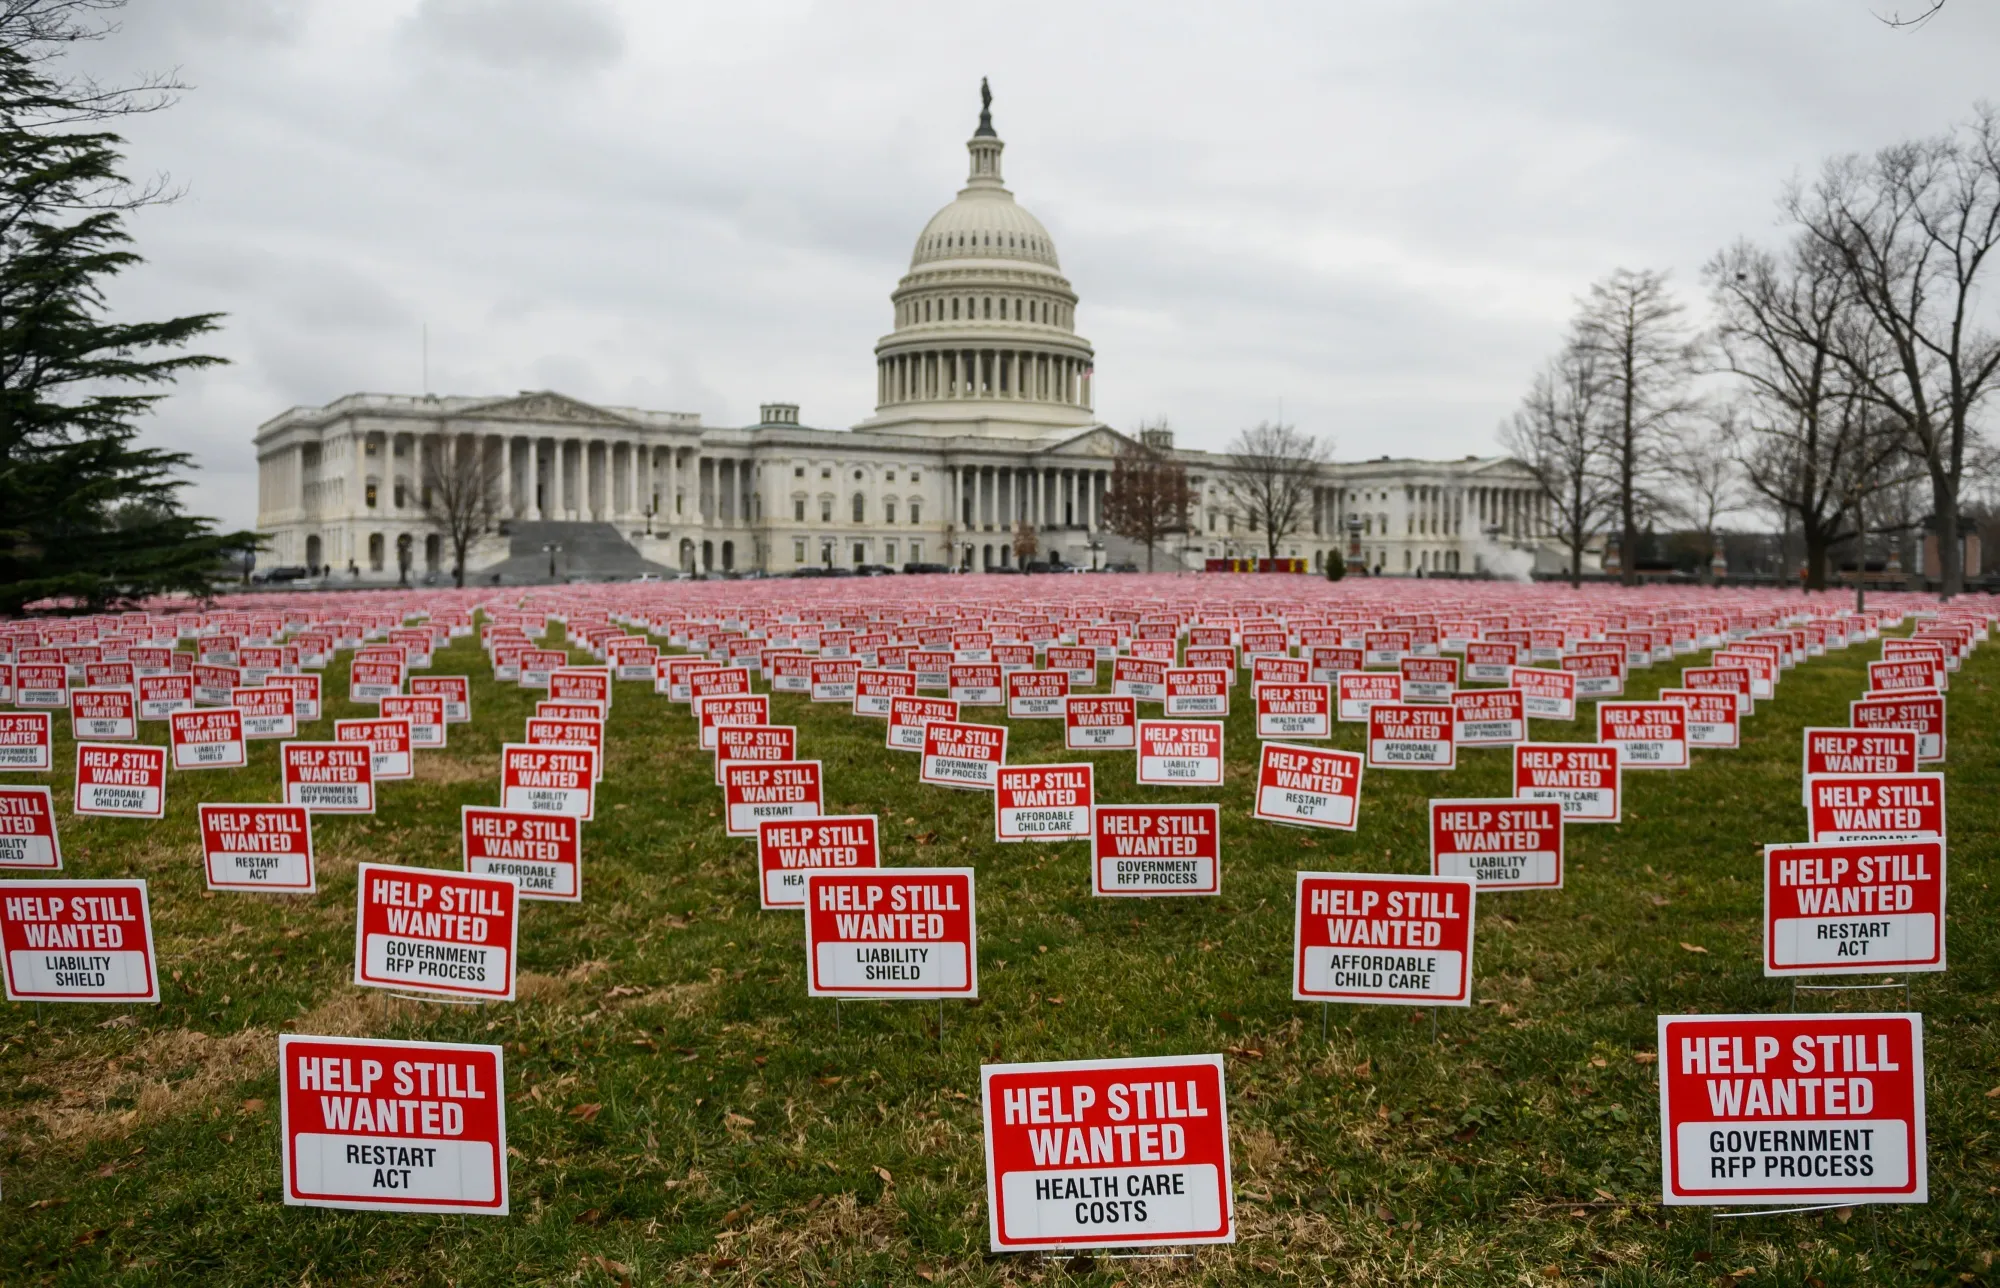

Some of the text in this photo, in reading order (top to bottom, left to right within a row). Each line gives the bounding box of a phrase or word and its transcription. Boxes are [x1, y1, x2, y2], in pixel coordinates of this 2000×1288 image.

[1263, 689, 1324, 701] HELP STILL
[1270, 702, 1317, 713] WANTED
[16, 718, 45, 731] STILL
[176, 715, 238, 730] HELP STILL
[1375, 713, 1449, 726] HELP STILL
[1605, 710, 1680, 724] HELP STILL
[184, 728, 232, 743] WANTED
[722, 734, 789, 746] HELP STILL
[929, 729, 1000, 748] HELP STILL
[1145, 727, 1216, 742] HELP STILL
[1382, 727, 1440, 740] WANTED
[1613, 725, 1671, 738] WANTED
[730, 747, 781, 759] WANTED
[935, 744, 990, 760] WANTED
[1152, 742, 1208, 756] WANTED
[1813, 737, 1857, 755] HELP
[1862, 738, 1909, 756] STILL
[84, 751, 159, 770] HELP STILL
[289, 751, 365, 766] HELP STILL
[510, 753, 589, 771] HELP STILL
[935, 760, 987, 772] GOVERNMENT
[1268, 752, 1355, 778] HELP STILL
[1522, 753, 1611, 770] HELP STILL
[1823, 756, 1897, 773] WANTED
[91, 768, 149, 785] WANTED
[297, 766, 356, 781] WANTED
[518, 770, 578, 787] WANTED
[732, 770, 814, 786] HELP STILL
[1003, 772, 1085, 790] HELP STILL
[1276, 770, 1342, 794] WANTED
[1533, 772, 1601, 787] WANTED
[93, 788, 146, 799] AFFORDABLE
[742, 787, 804, 802] WANTED
[1012, 790, 1075, 807] WANTED
[1285, 793, 1327, 807] RESTART
[1574, 791, 1599, 801] CARE
[1819, 785, 1933, 806] HELP STILL
[0, 797, 44, 815] STILL
[1295, 804, 1314, 816] ACT
[209, 814, 303, 835] HELP STILL
[1016, 811, 1074, 822] AFFORDABLE
[1102, 815, 1209, 834] HELP STILL
[1441, 810, 1552, 830] HELP STILL
[1832, 807, 1920, 828] WANTED
[472, 817, 571, 843] HELP STILL
[768, 826, 868, 848] HELP STILL
[221, 835, 293, 854] WANTED
[484, 838, 559, 862] WANTED
[1115, 836, 1197, 854] WANTED
[1454, 831, 1539, 851] WANTED
[235, 859, 280, 870] RESTART
[780, 847, 857, 867] WANTED
[1116, 860, 1196, 872] GOVERNMENT
[1471, 856, 1527, 868] LIABILITY
[248, 870, 268, 881] ACT
[488, 863, 557, 878] AFFORDABLE
[1116, 872, 1196, 885] RFP PROCESS
[1478, 868, 1520, 880] SHIELD
[1779, 854, 1930, 887] HELP STILL
[527, 877, 554, 890] CARE
[371, 879, 505, 916] HELP STILL
[819, 884, 884, 910] HELP
[890, 883, 961, 910] STILL
[1310, 888, 1460, 919] HELP STILL
[1796, 885, 1912, 916] WANTED
[8, 894, 137, 919] HELP STILL
[25, 922, 125, 946] WANTED
[384, 908, 488, 942] WANTED
[835, 913, 944, 938] WANTED
[1326, 918, 1440, 947] WANTED
[1816, 922, 1888, 940] RESTART
[385, 942, 485, 965] GOVERNMENT
[856, 948, 928, 963] LIABILITY
[1836, 941, 1867, 957] ACT
[47, 955, 112, 969] LIABILITY
[385, 958, 484, 982] RFP PROCESS
[1330, 954, 1435, 973] AFFORDABLE
[56, 971, 106, 986] SHIELD
[865, 965, 920, 981] SHIELD
[1334, 971, 1430, 990] CHILD CARE
[1680, 1036, 1901, 1077] HELP STILL
[299, 1056, 485, 1100] HELP STILL
[1002, 1078, 1206, 1124] HELP STILL
[1706, 1080, 1875, 1118] WANTED
[320, 1096, 464, 1136] WANTED
[1026, 1122, 1184, 1165] WANTED
[1709, 1132, 1874, 1155] GOVERNMENT
[346, 1143, 437, 1167] RESTART
[1711, 1157, 1874, 1180] RFP PROCESS
[372, 1167, 411, 1189] ACT
[1036, 1173, 1184, 1200] HEALTH CARE
[1075, 1200, 1147, 1224] COSTS
